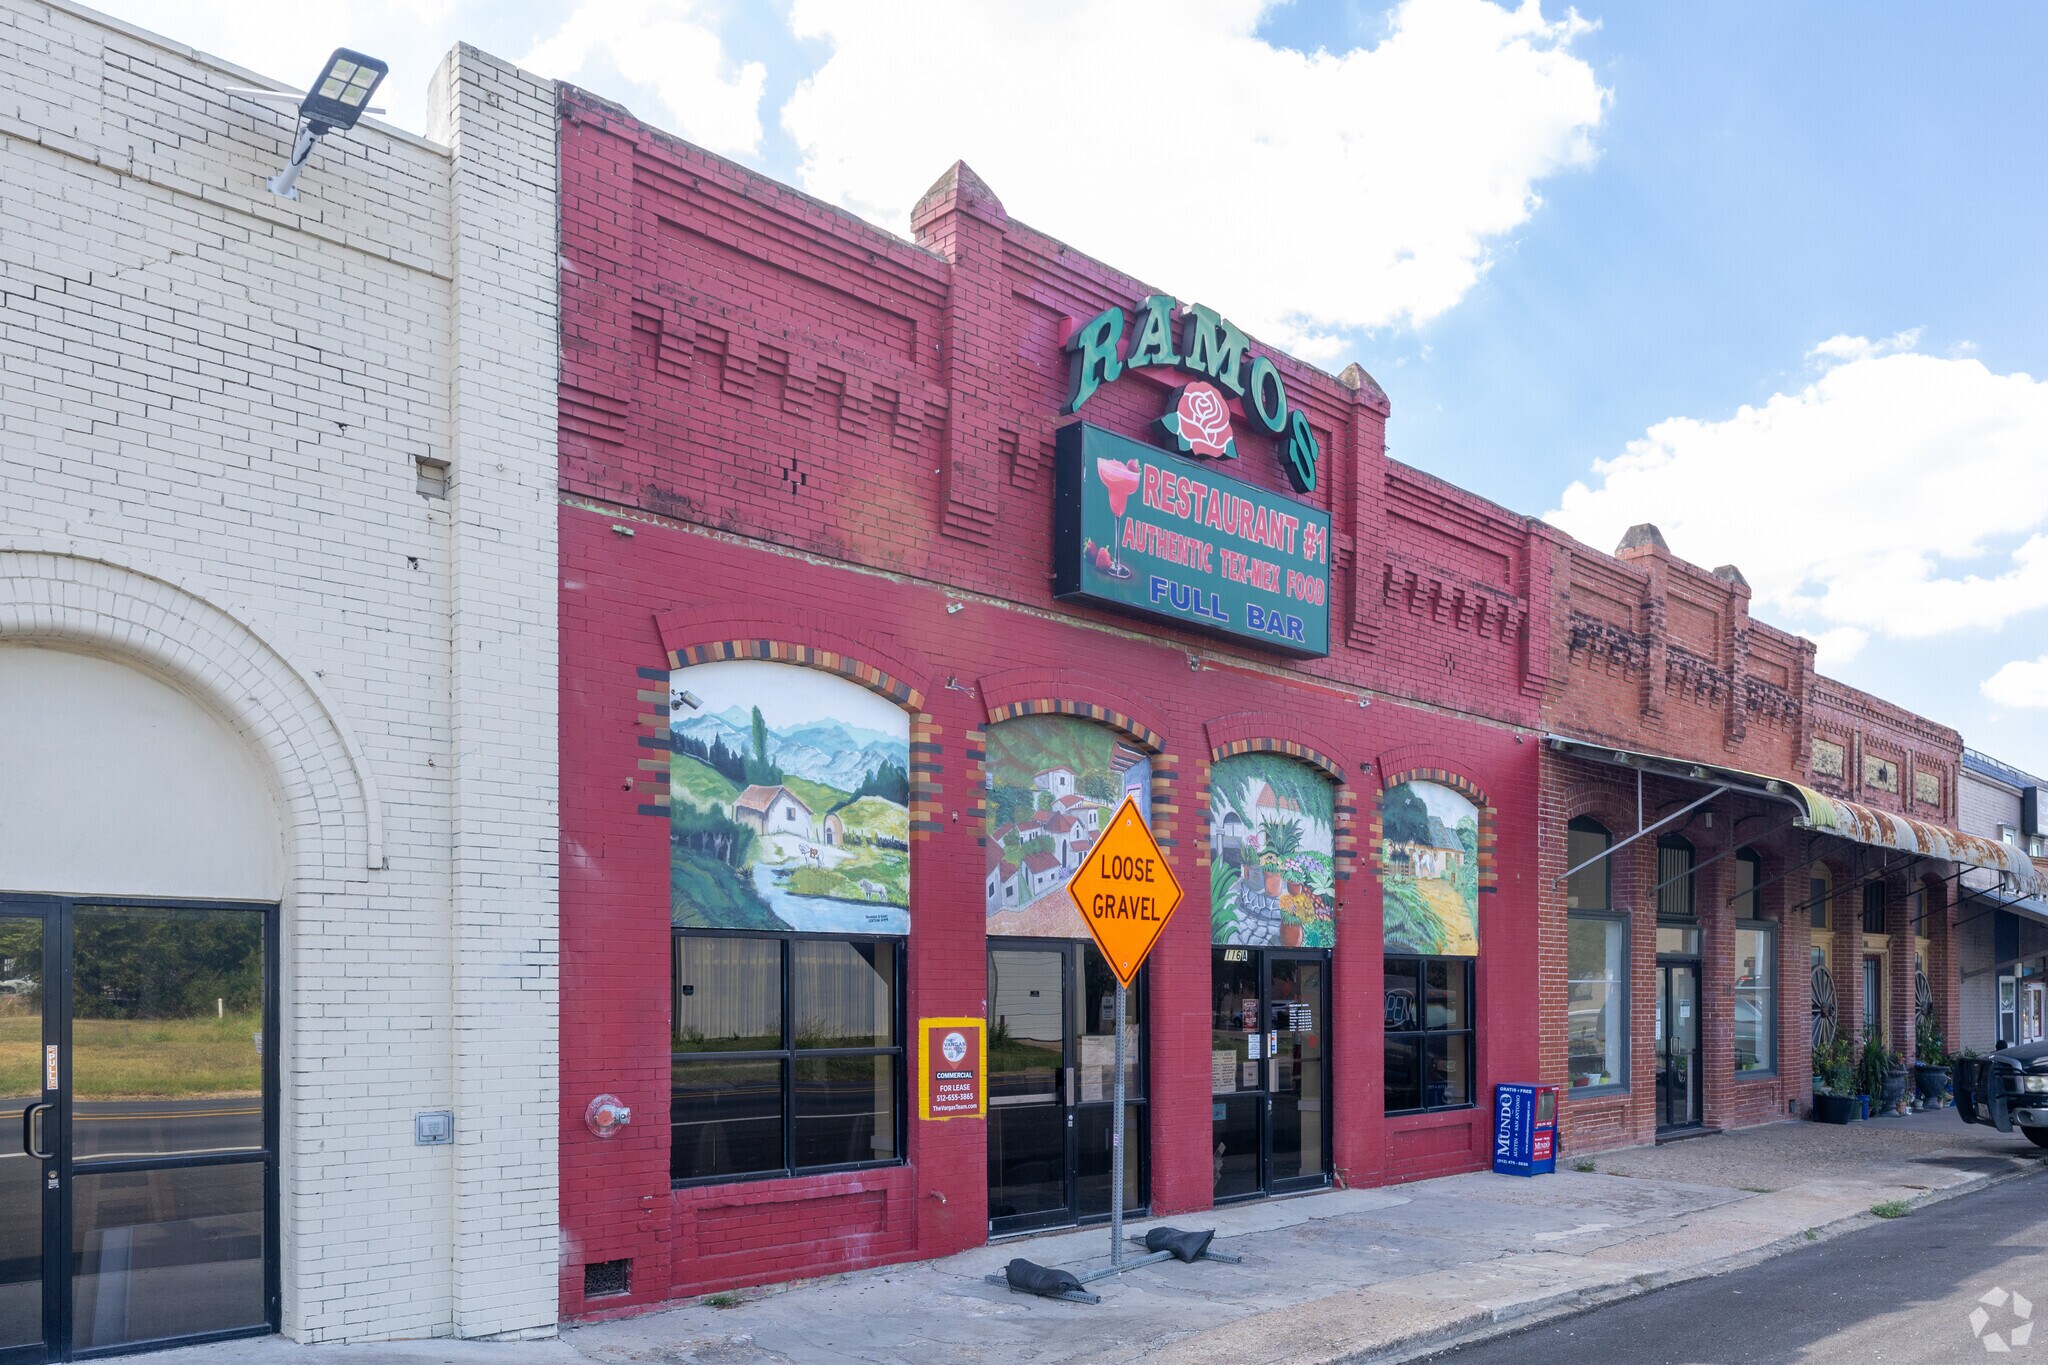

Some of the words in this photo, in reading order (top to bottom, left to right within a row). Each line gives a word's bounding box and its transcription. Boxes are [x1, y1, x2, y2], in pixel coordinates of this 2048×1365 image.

[1061, 294, 1319, 493] RAMOS
[1143, 463, 1298, 555] RESTAURANT
[1303, 521, 1327, 564] #1
[1122, 517, 1213, 574] AUTHENTIC
[1220, 547, 1280, 595] TEX-MEX
[1286, 572, 1324, 607] FOOD
[1149, 575, 1229, 622] FULL
[1246, 603, 1305, 643] BAR
[1101, 854, 1155, 883] LOOSE
[1093, 893, 1160, 922] GRAVEL
[1225, 950, 1247, 961] 116A
[1384, 995, 1413, 1021] PEN
[1497, 1094, 1512, 1156] MUNDO
